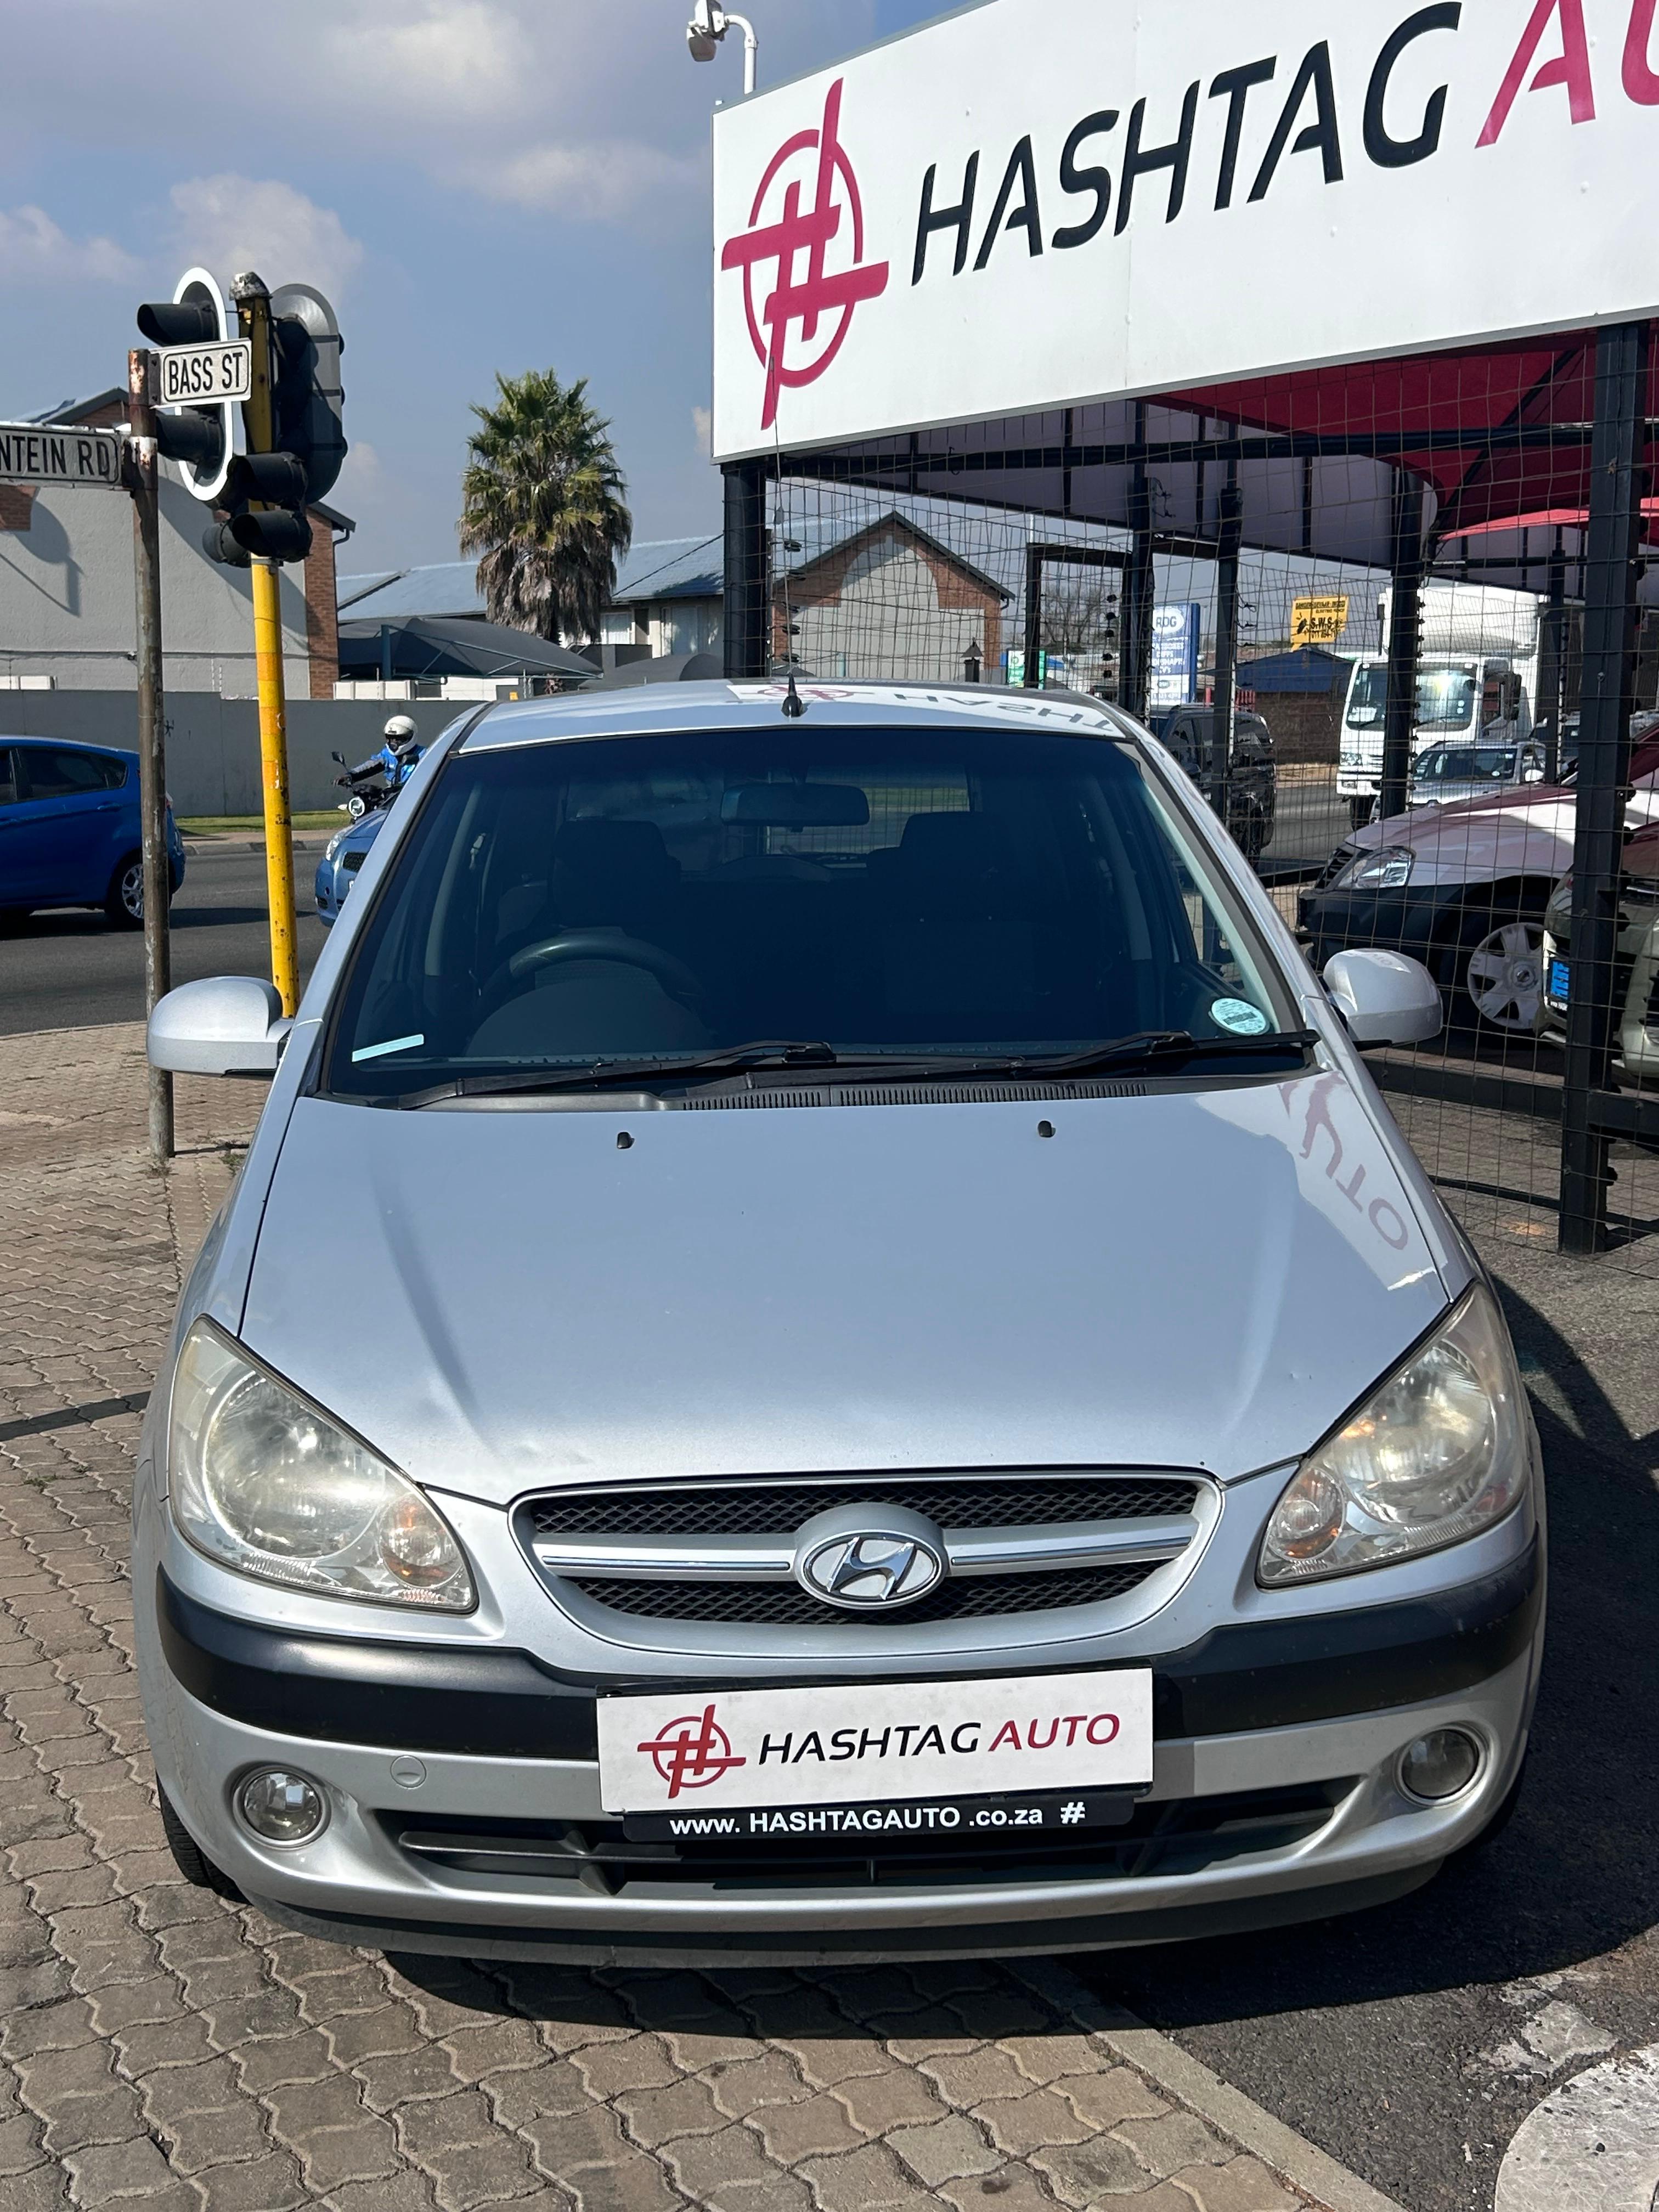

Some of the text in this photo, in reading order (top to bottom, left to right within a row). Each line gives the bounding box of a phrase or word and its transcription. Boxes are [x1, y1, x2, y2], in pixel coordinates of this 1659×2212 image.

[911, 1, 1462, 286] HASHTAG
[168, 352, 243, 396] BASS ST
[77, 439, 110, 477] RD
[759, 1713, 1120, 1765] HASHTAG AUTO
[670, 1801, 1086, 1835] www. HASHTAGAUTO .co.za #
